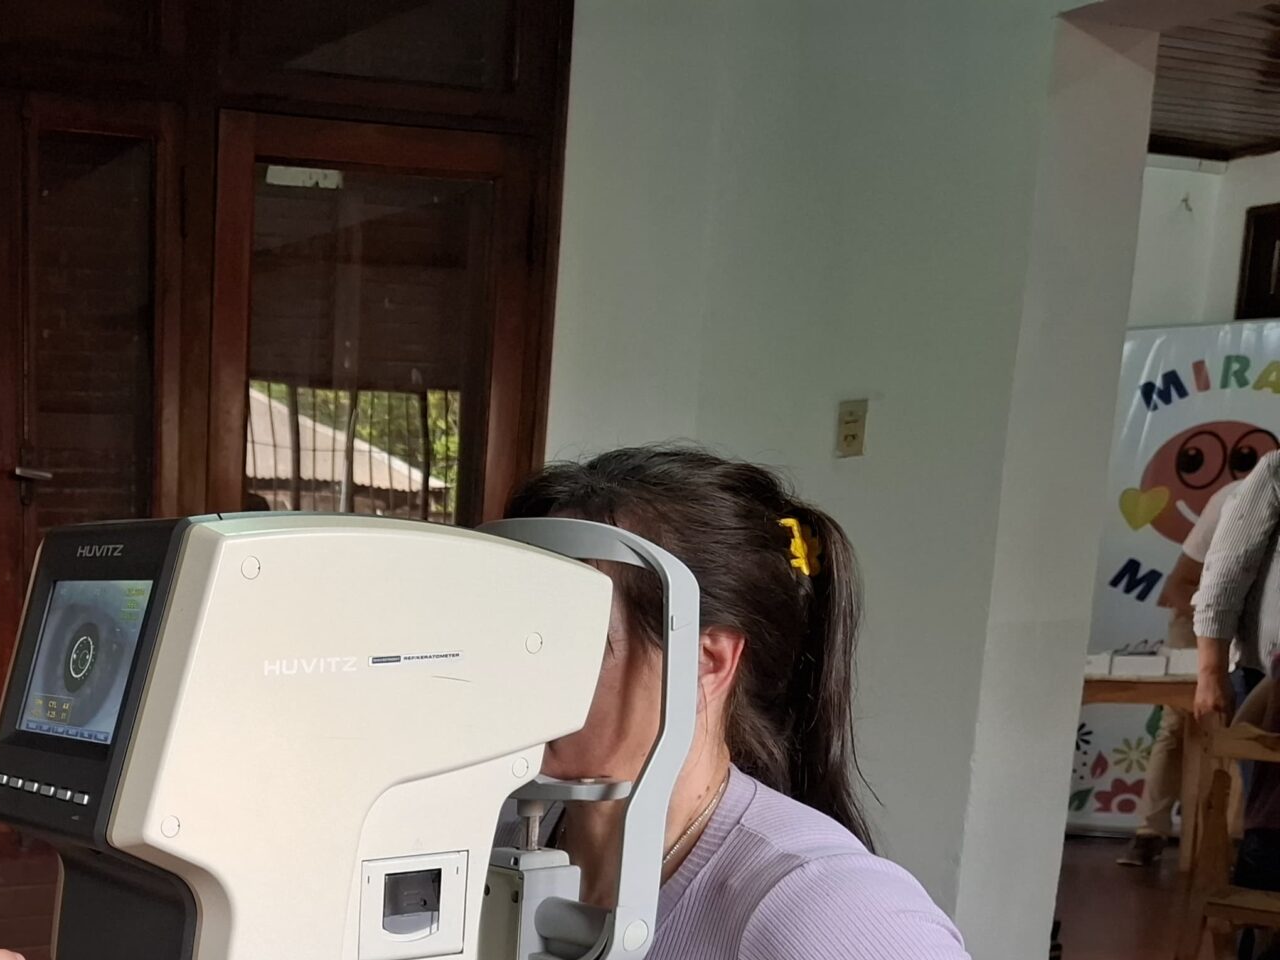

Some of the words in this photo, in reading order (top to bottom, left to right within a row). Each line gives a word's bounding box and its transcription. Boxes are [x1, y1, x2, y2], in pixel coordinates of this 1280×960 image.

[1140, 354, 1280, 412] MIRA
[76, 544, 124, 557] HUVITZ
[264, 657, 357, 676] HUVITZ
